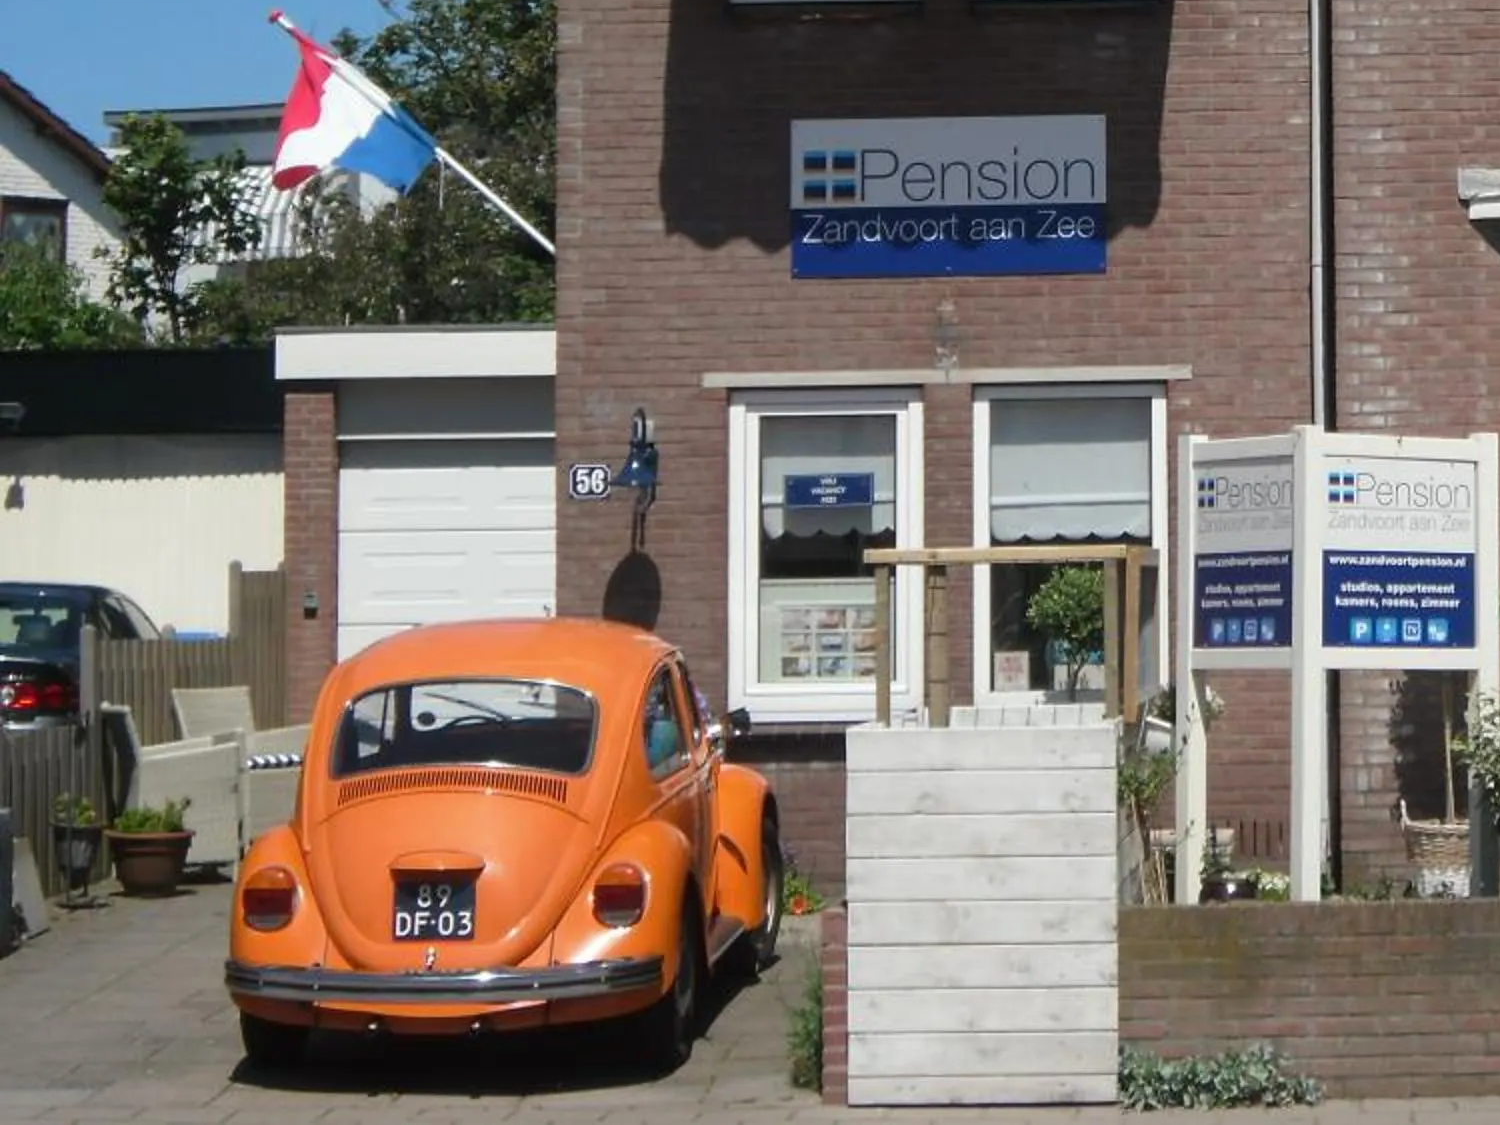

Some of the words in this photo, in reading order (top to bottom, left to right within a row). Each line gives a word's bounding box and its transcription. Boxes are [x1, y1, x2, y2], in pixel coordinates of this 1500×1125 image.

[861, 146, 1095, 201] Pension
[803, 212, 959, 243] Zandvoort
[970, 216, 1024, 241] aan
[1036, 210, 1096, 240] Zee
[576, 468, 605, 493] 56
[1356, 473, 1471, 508] Pension
[1328, 511, 1404, 530] Zandvoort
[1355, 622, 1368, 639] P
[417, 884, 451, 908] 89
